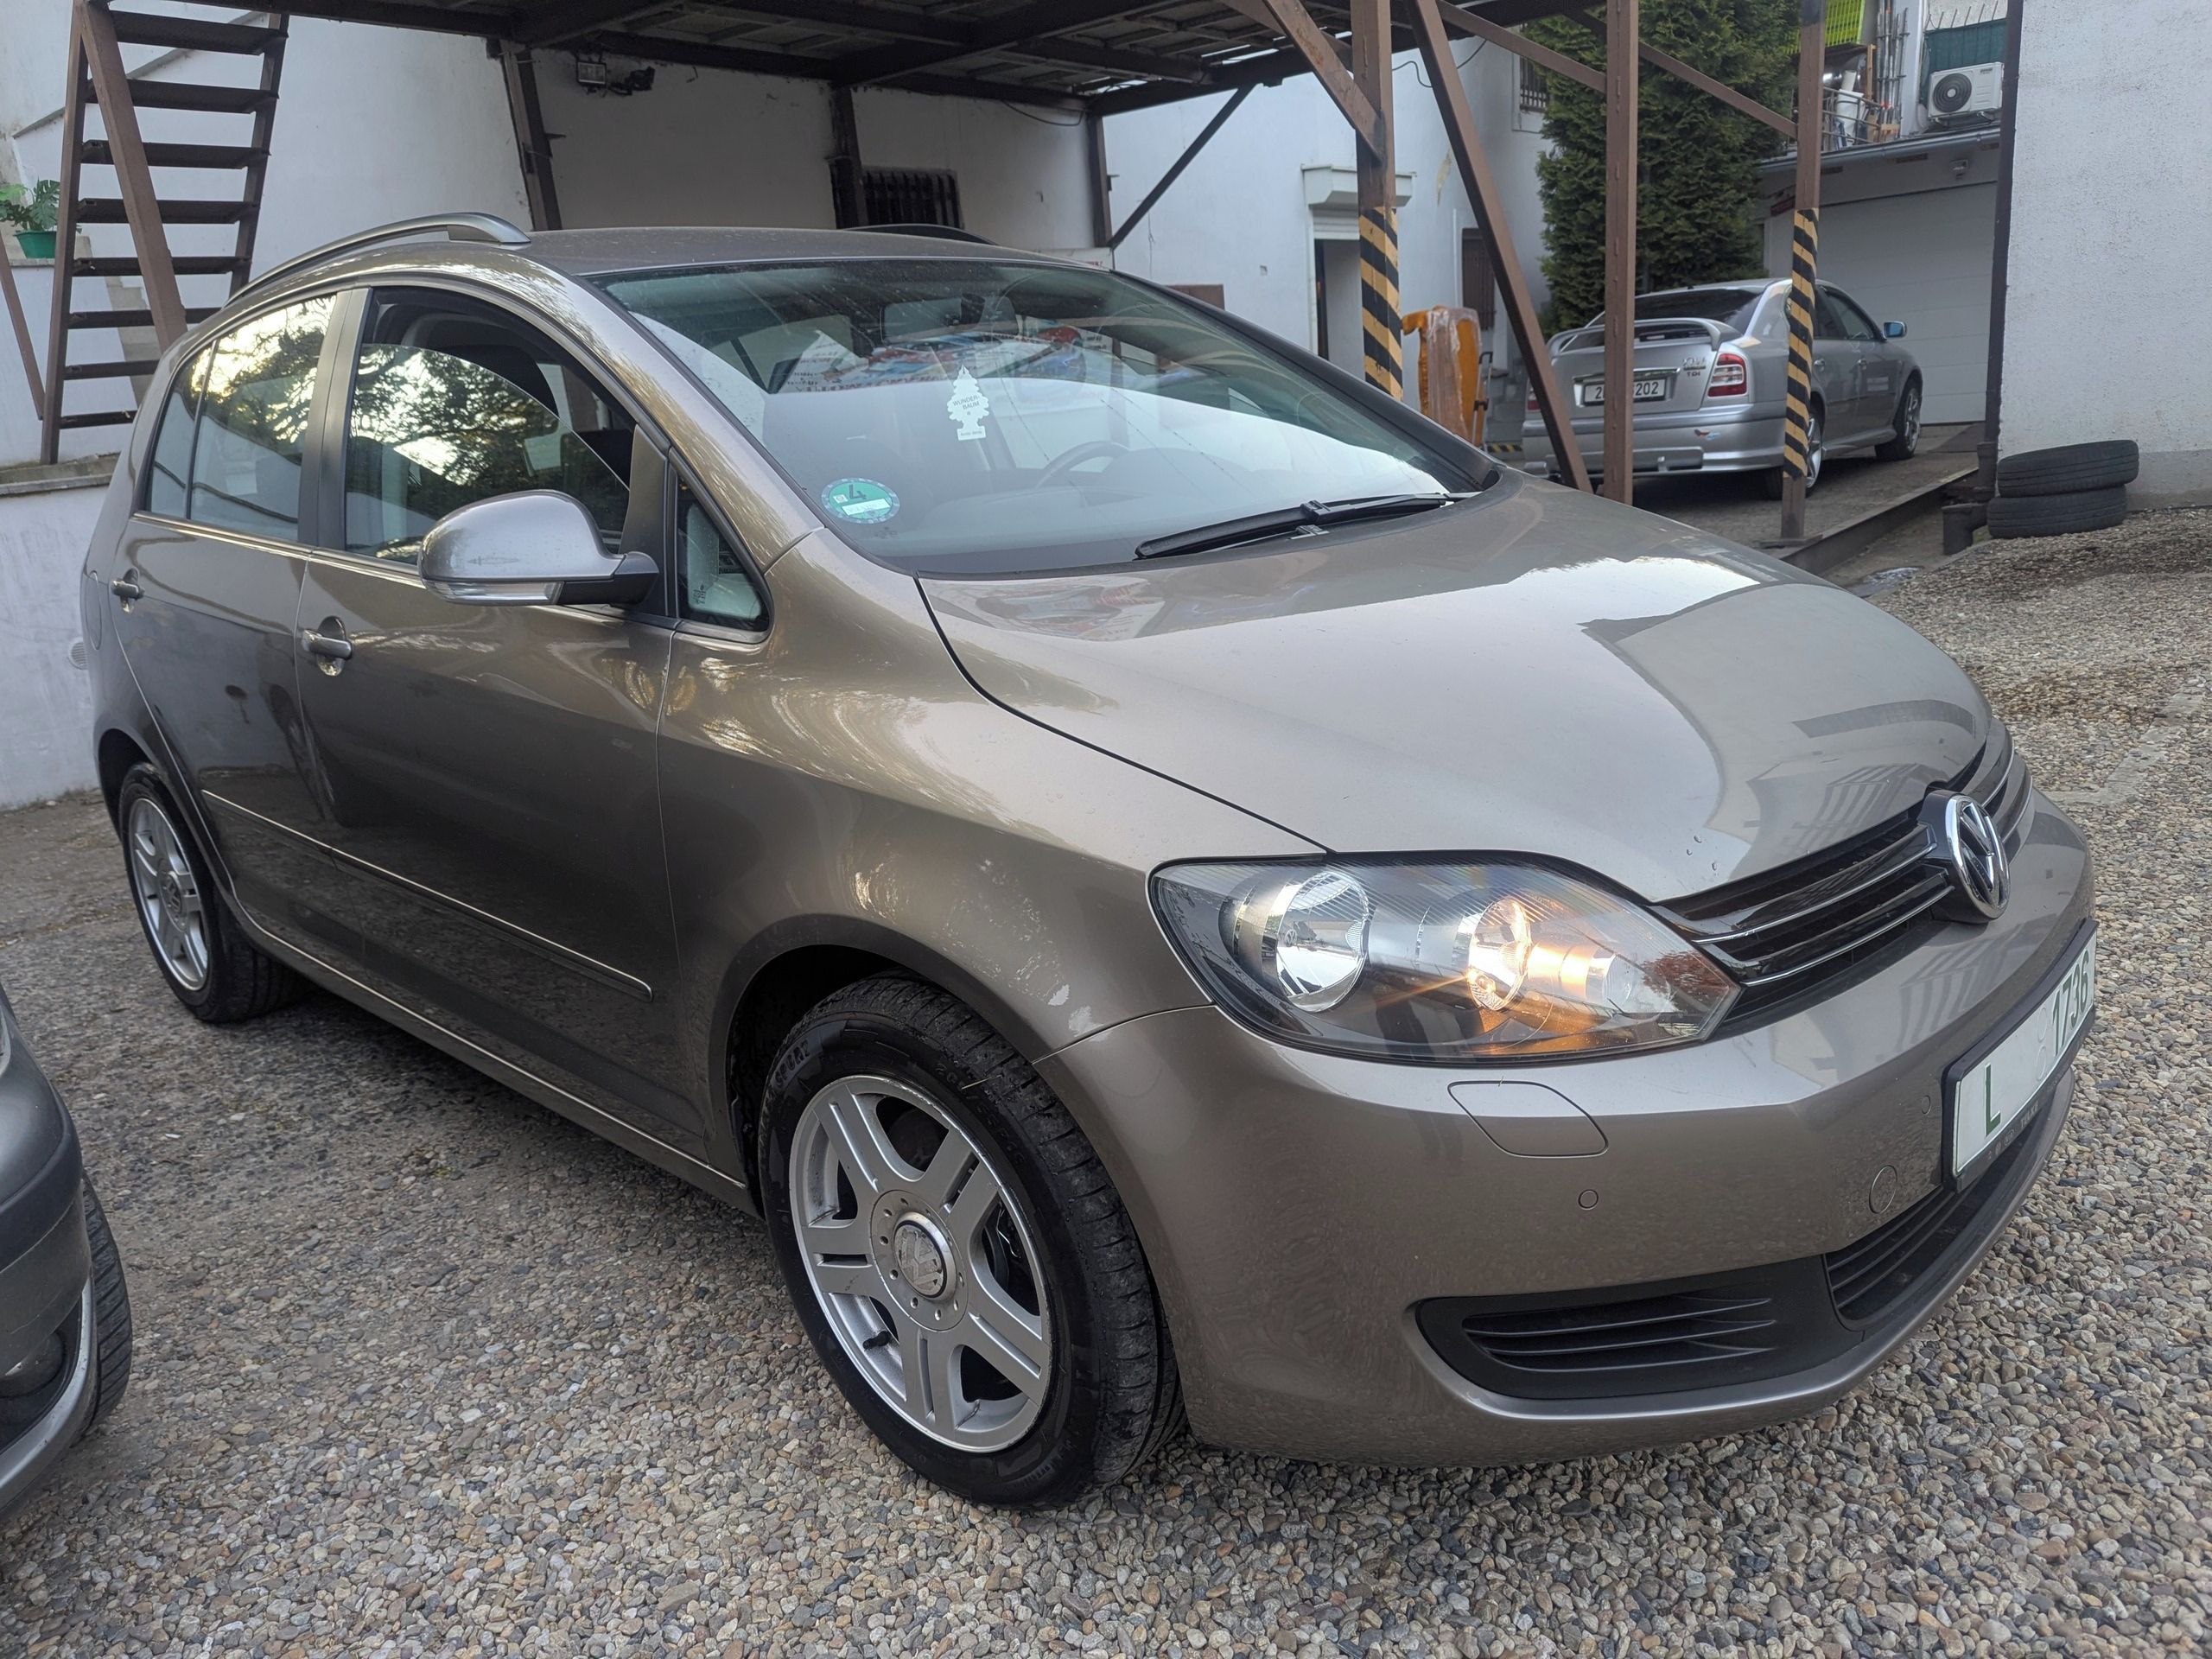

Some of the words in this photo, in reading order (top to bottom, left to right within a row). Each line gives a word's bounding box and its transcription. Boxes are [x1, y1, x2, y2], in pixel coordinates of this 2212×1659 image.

[1633, 381, 1659, 397] 202
[962, 400, 980, 410] BAUM
[849, 483, 868, 500] 4
[1985, 1062, 2001, 1137] L
[2052, 949, 2089, 1058] 1736
